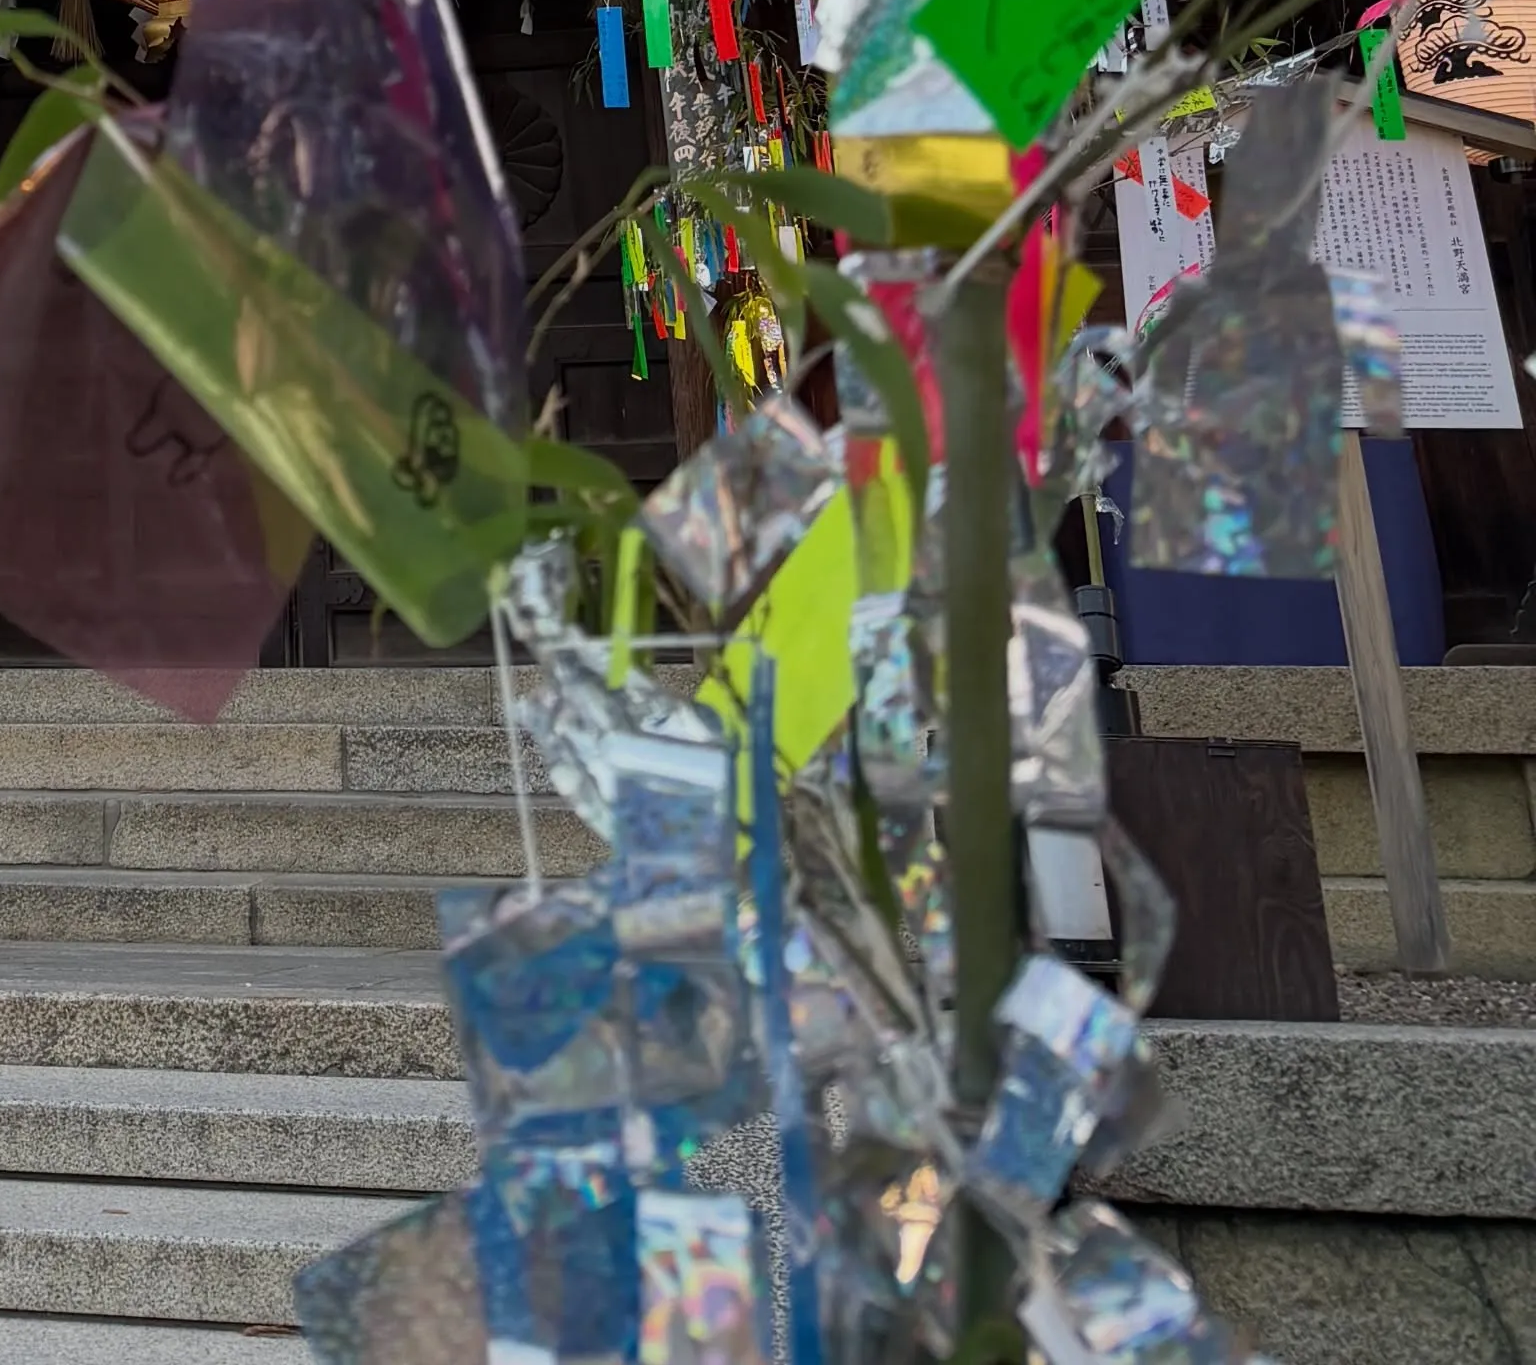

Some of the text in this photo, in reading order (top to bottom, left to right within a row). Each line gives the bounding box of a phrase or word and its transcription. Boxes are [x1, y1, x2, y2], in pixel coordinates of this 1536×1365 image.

[1451, 236, 1471, 295] 北野天満宮
